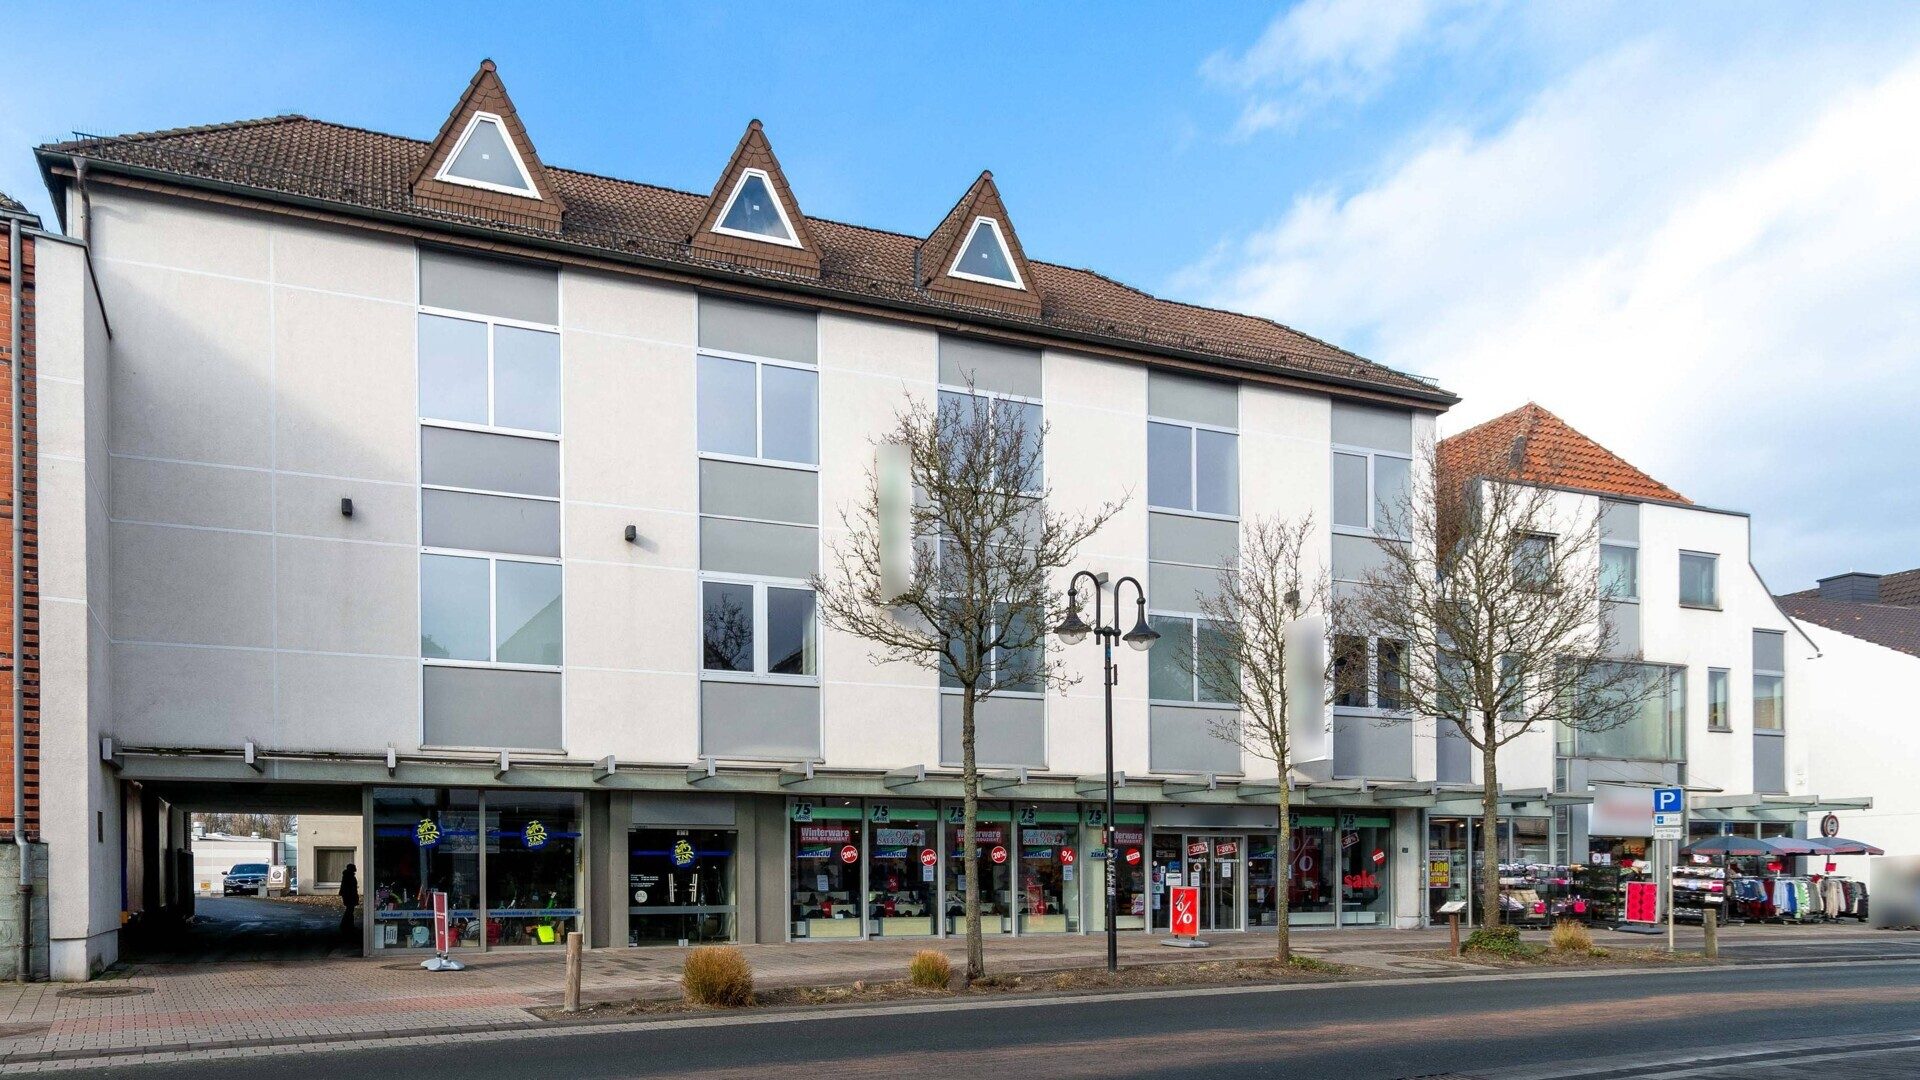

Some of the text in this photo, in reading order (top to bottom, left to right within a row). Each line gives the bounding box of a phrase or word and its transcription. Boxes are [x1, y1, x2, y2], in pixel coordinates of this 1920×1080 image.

[1660, 792, 1675, 810] P
[796, 804, 810, 814] 75
[874, 806, 888, 816] 75
[950, 806, 964, 817] 75
[1022, 808, 1034, 818] 75
[1089, 810, 1101, 820] 75
[1344, 814, 1354, 824] 75
[801, 828, 850, 837] Winterware
[957, 829, 1000, 838] Wrware
[1103, 831, 1143, 839] Wterware
[842, 850, 857, 859] 20%
[923, 853, 936, 862] 20%
[993, 850, 1006, 859] 20%
[1062, 851, 1073, 861] %
[1344, 870, 1376, 888] sale
[1176, 901, 1192, 925] %
